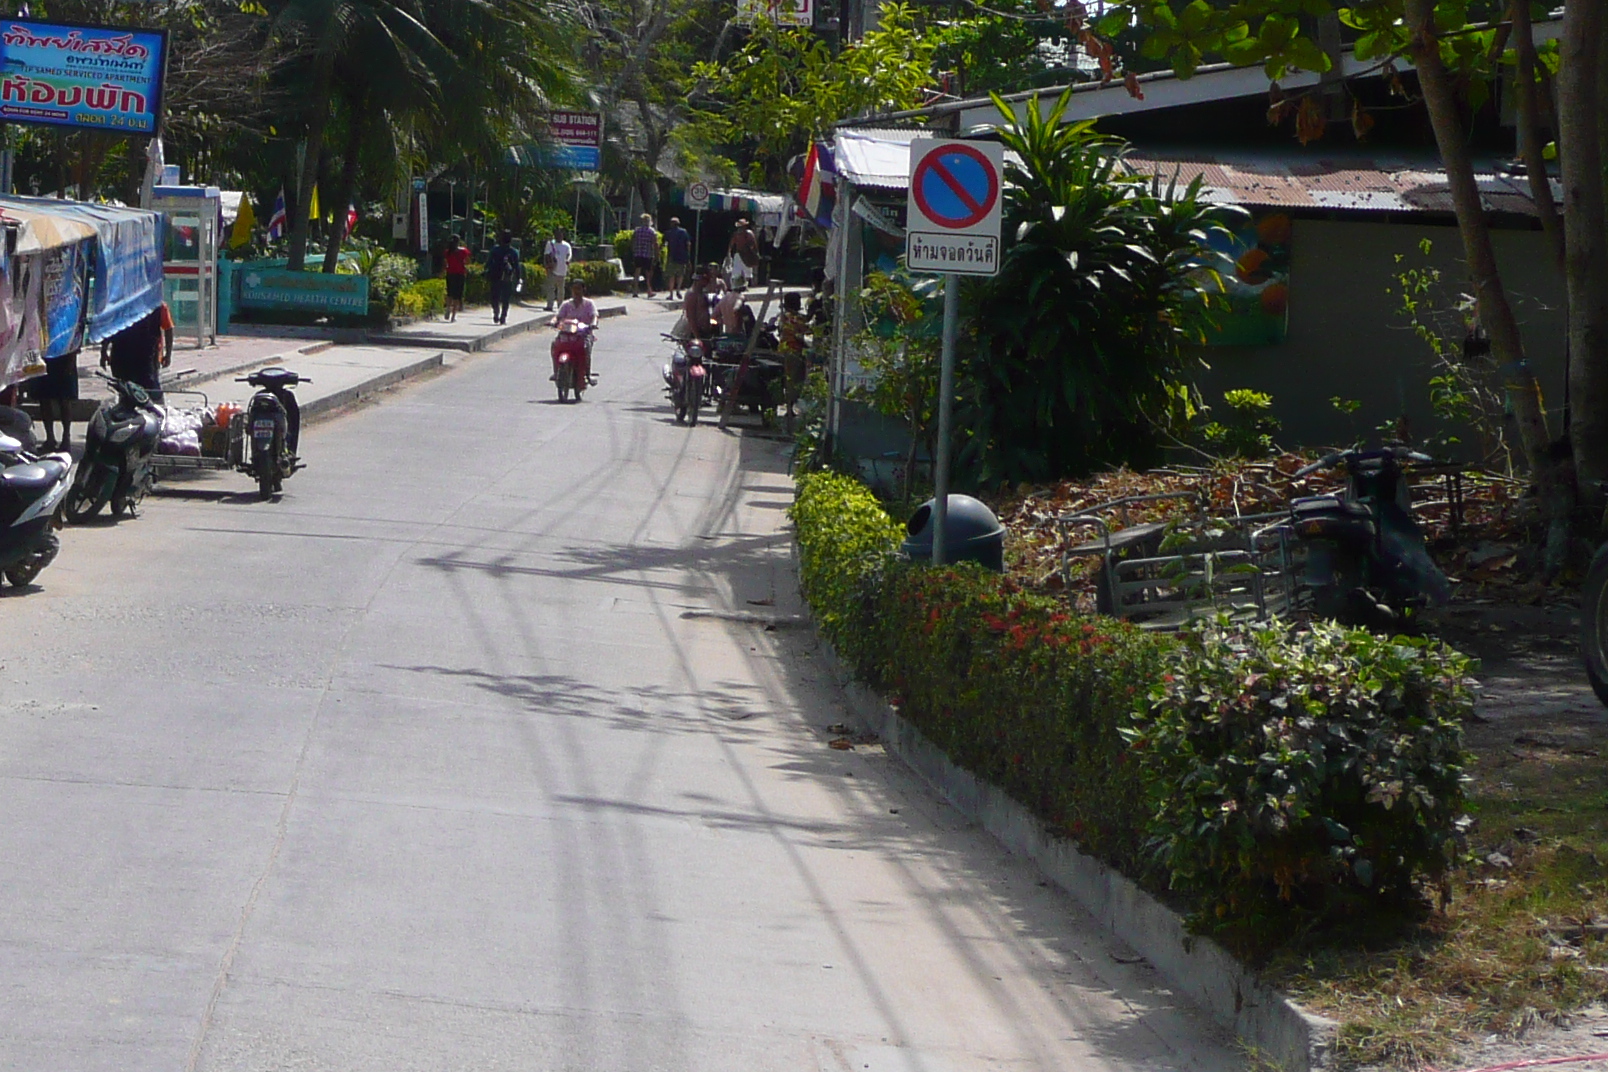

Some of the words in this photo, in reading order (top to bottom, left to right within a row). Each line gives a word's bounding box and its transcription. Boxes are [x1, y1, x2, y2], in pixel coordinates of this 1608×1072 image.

[64, 69, 103, 80] SERVICED
[104, 72, 152, 84] APARTMENT
[1, 74, 147, 115] ห้องพัก
[110, 114, 125, 126] 24
[569, 114, 597, 126] STATION
[913, 236, 994, 264] ห้ามจอดวันคี่
[293, 293, 327, 305] HEALTH
[329, 296, 365, 308] CENTRE
